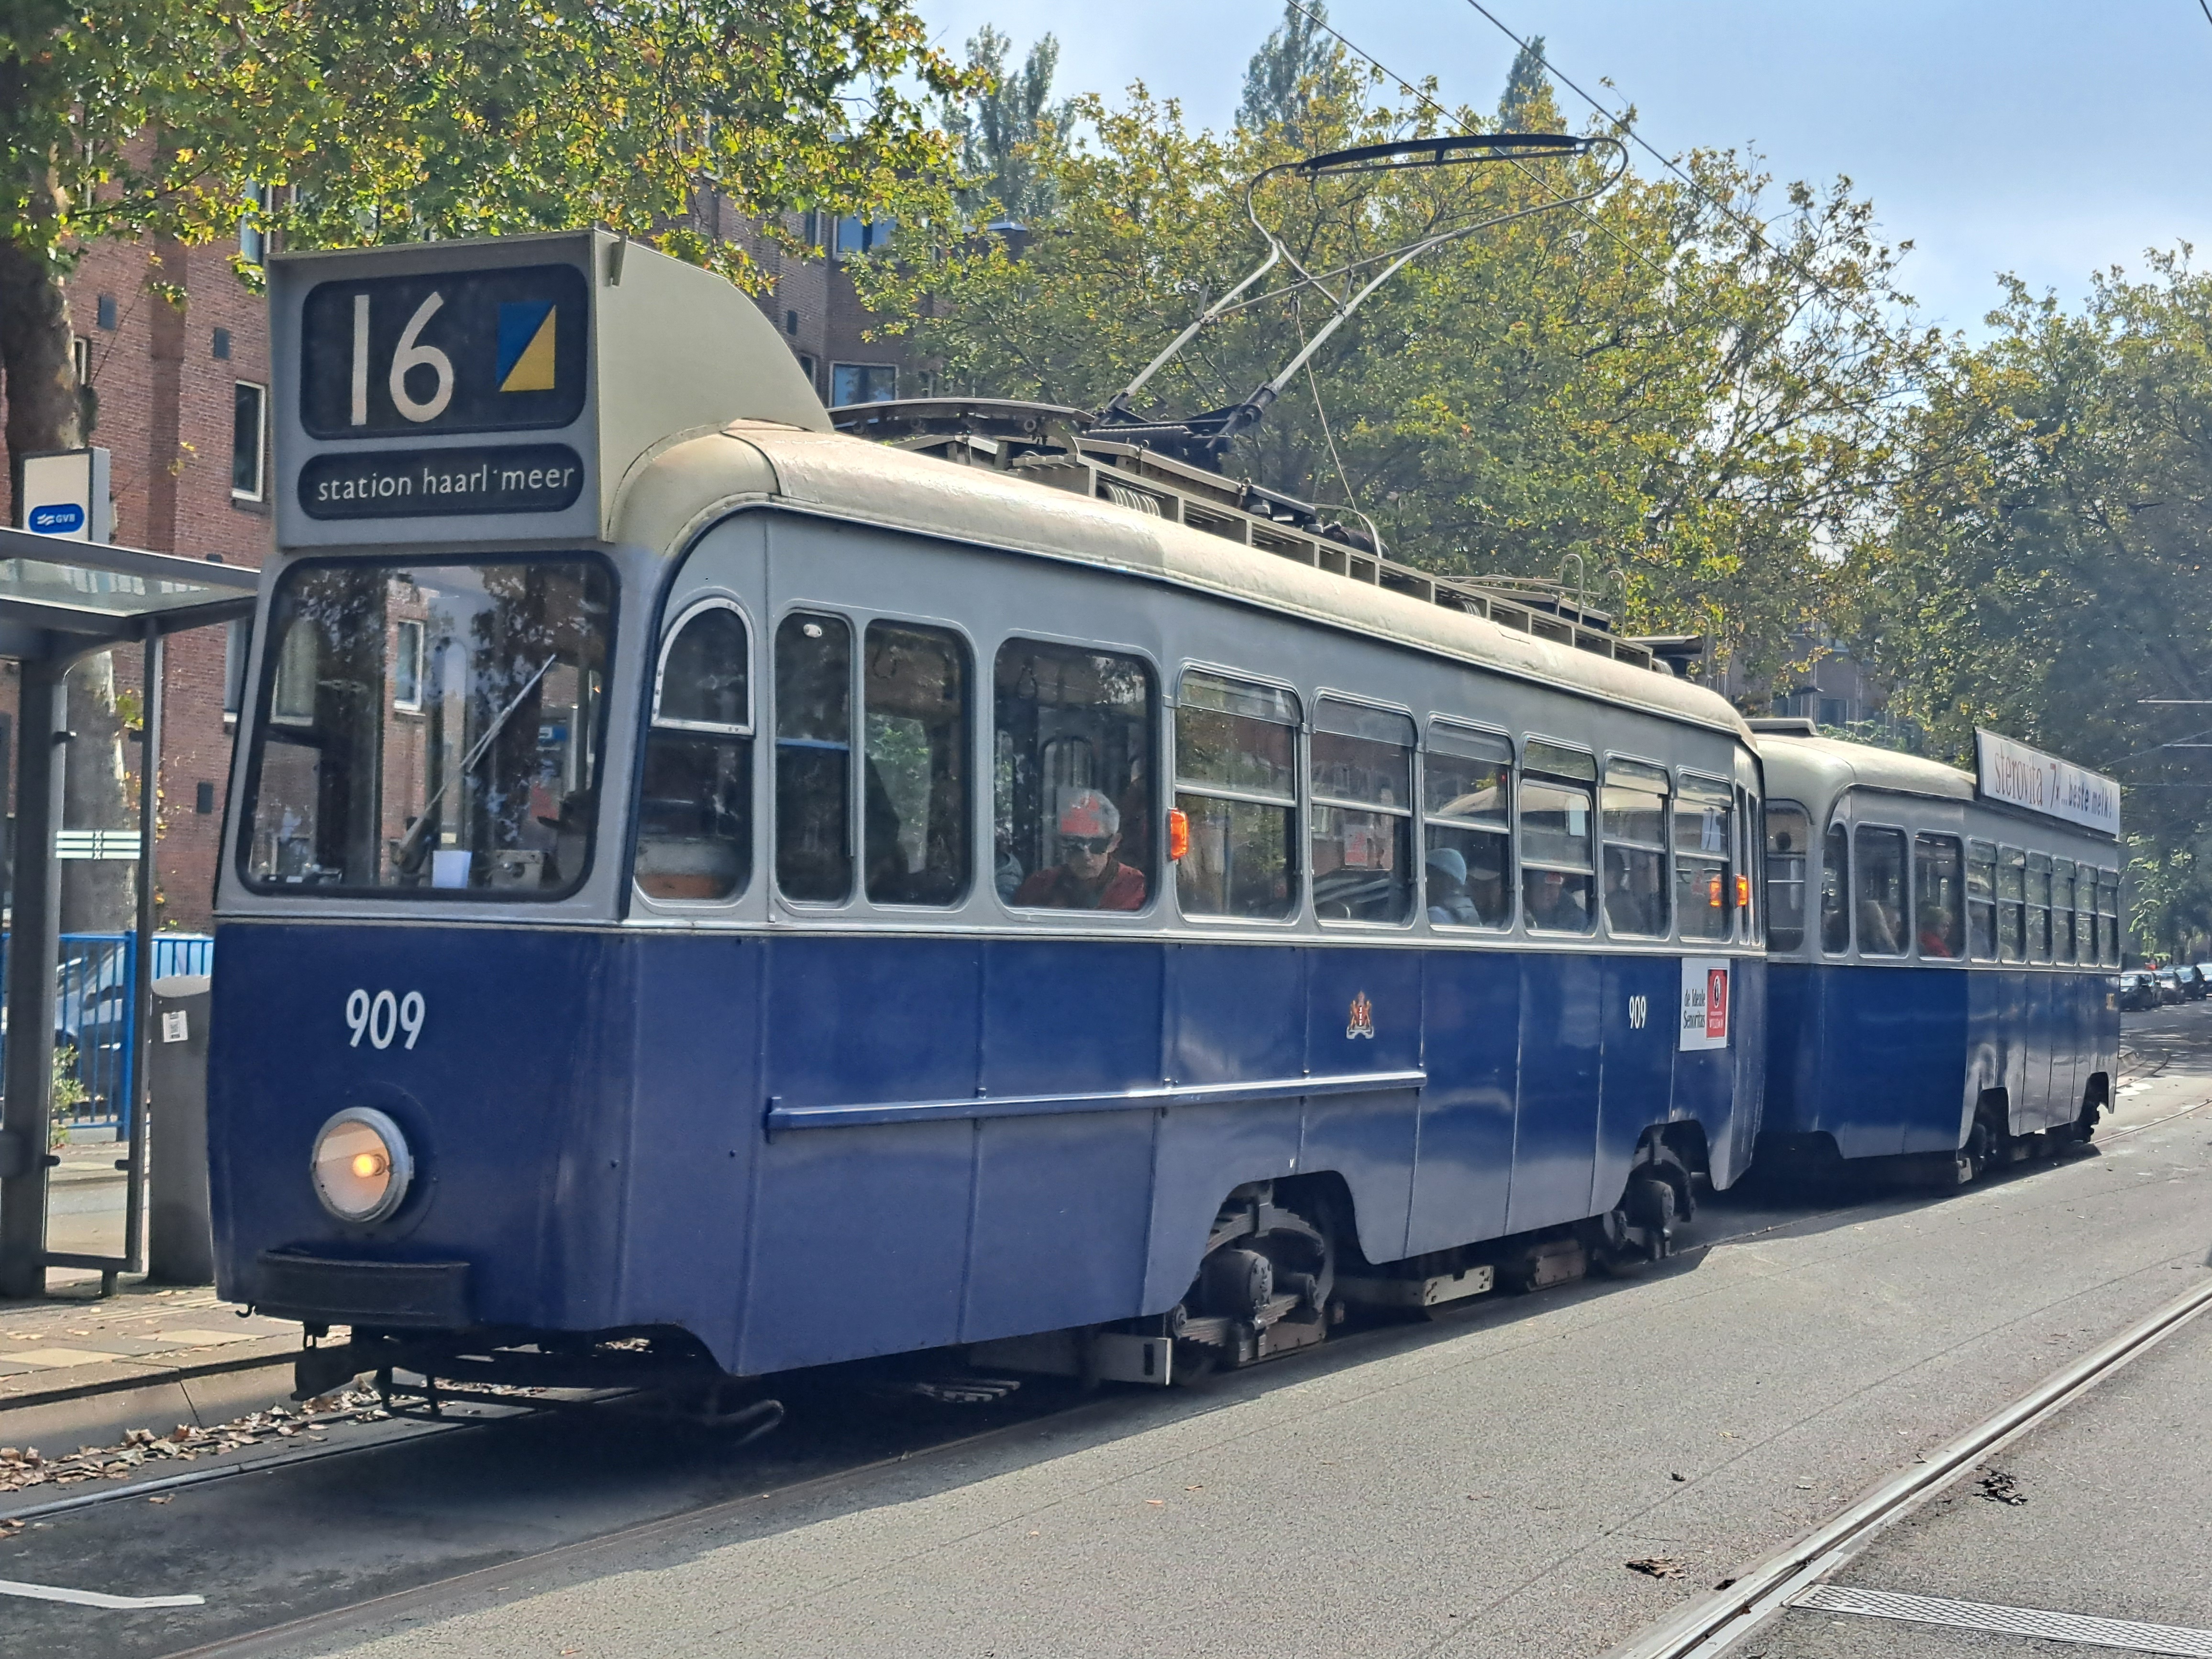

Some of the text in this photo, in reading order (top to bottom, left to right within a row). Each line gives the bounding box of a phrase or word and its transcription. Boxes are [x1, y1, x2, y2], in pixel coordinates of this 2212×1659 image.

[351, 291, 453, 426] 16
[318, 473, 412, 502] station
[55, 513, 76, 523] GVB
[1994, 743, 2043, 807] sterovita
[346, 988, 425, 1050] 909
[1629, 995, 1646, 1029] 909
